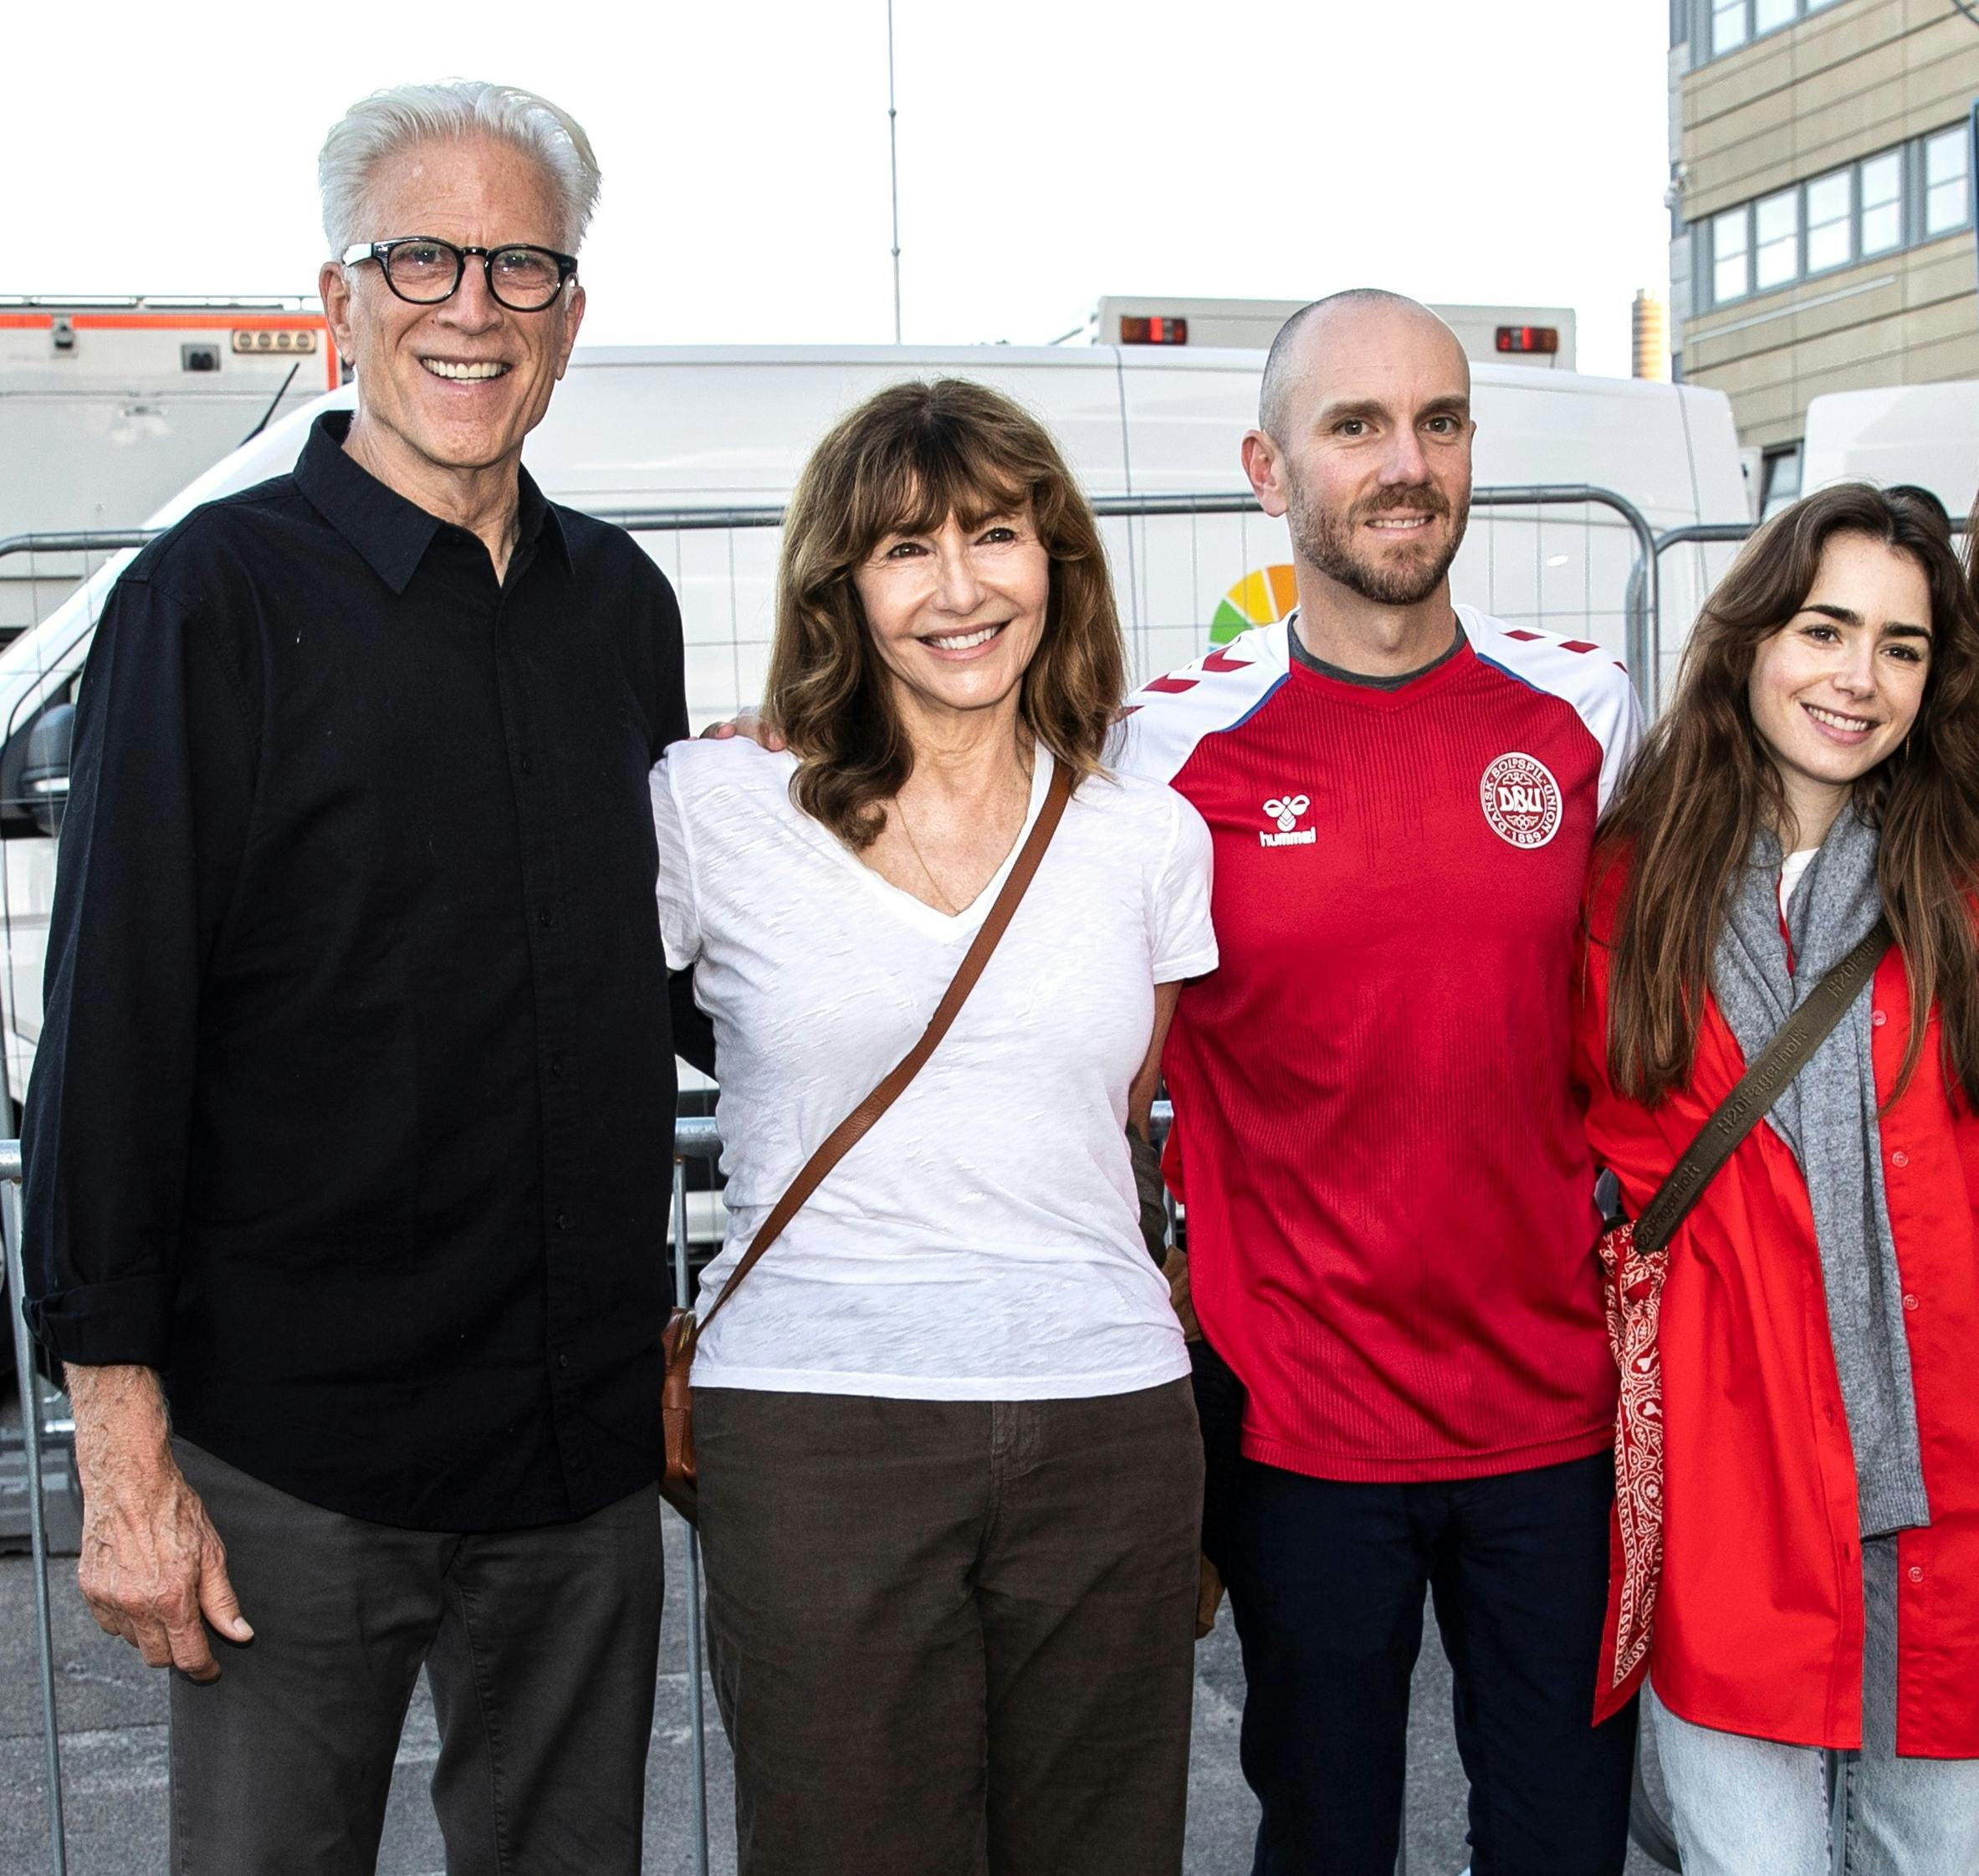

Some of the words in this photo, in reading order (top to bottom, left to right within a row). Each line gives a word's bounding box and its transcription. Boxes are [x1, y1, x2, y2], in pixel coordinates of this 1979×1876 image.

[1484, 781, 1508, 833] DANSK
[1542, 785, 1557, 834] UNION
[1497, 785, 1543, 813] DBU
[1259, 826, 1317, 847] hummel
[1511, 831, 1542, 844] 1889
